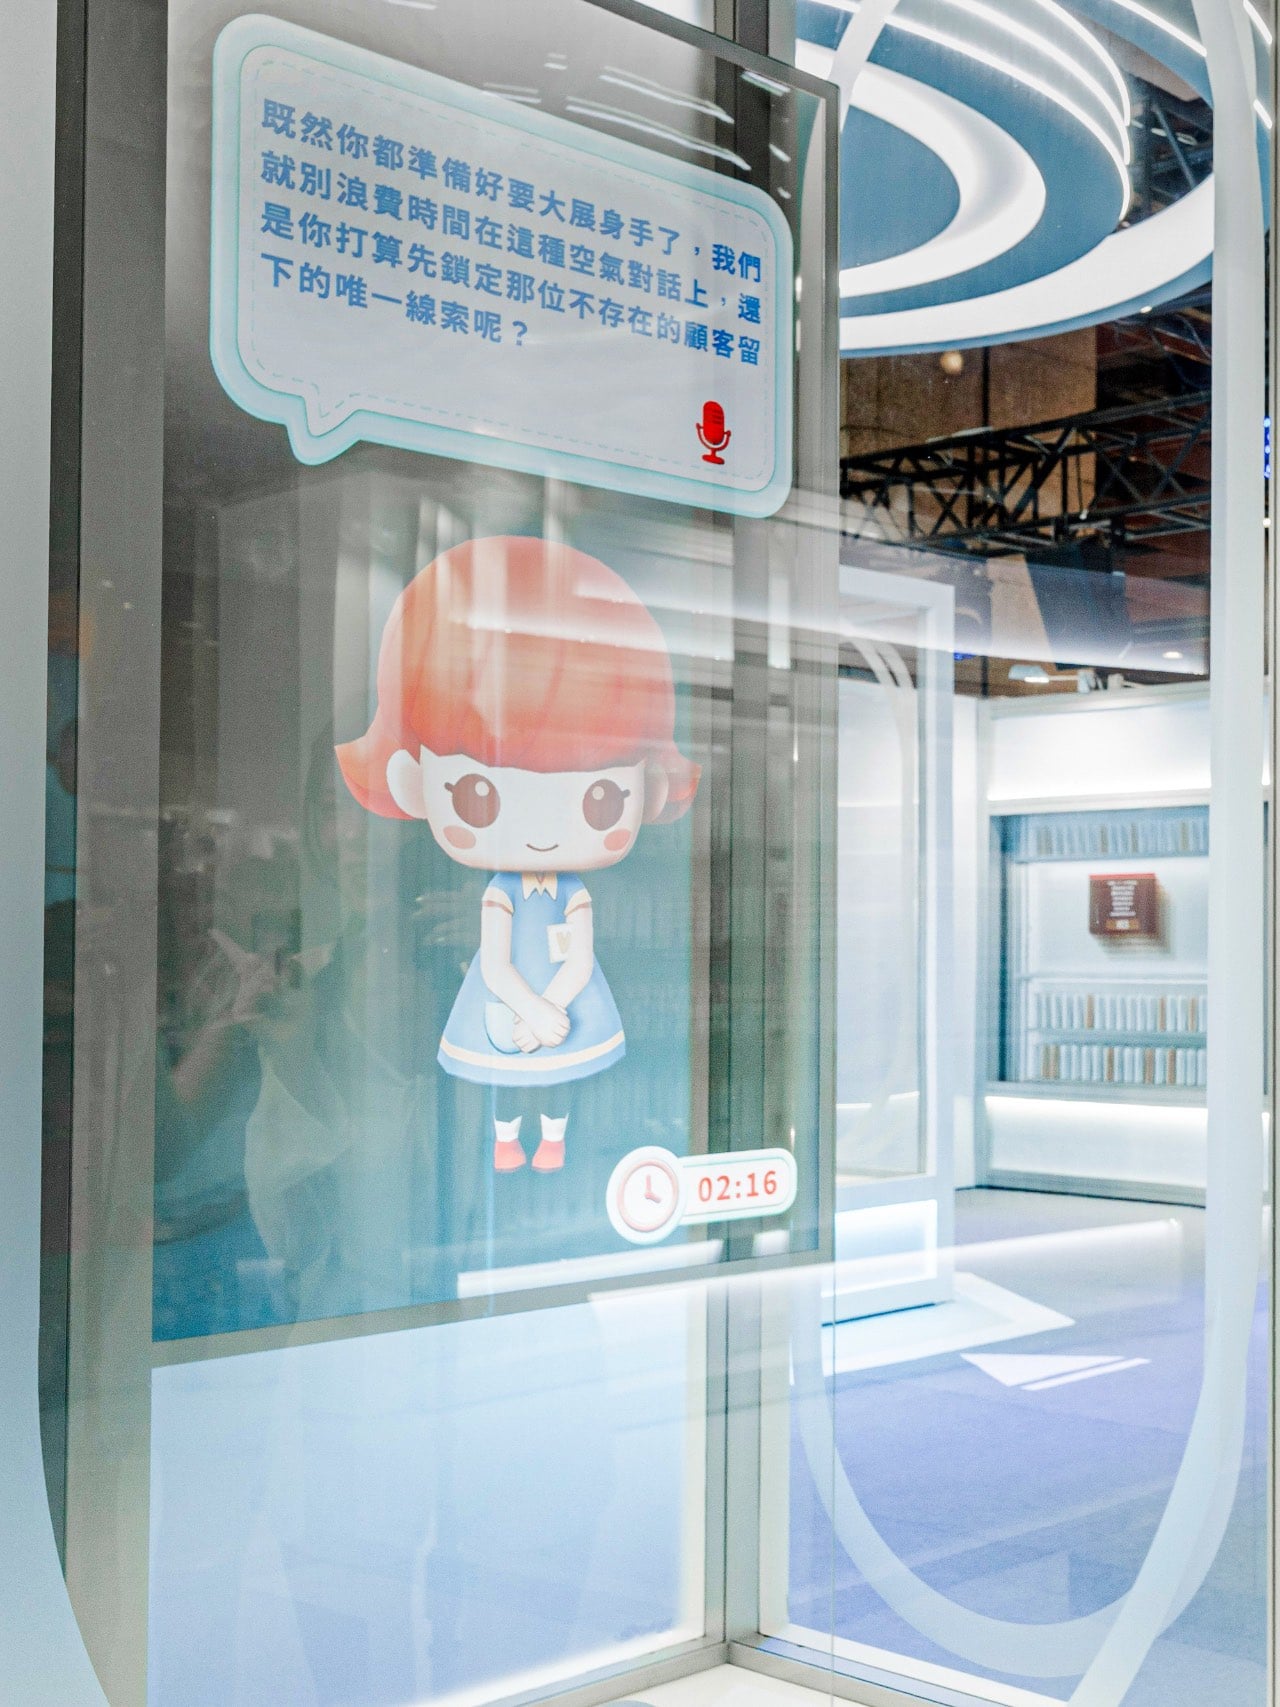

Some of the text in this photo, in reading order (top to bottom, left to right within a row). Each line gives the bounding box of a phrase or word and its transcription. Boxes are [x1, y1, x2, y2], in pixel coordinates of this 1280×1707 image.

[260, 201, 760, 366] 是你打算先鎖定那位不存在的顧客留
[698, 1170, 777, 1202] 02:16
